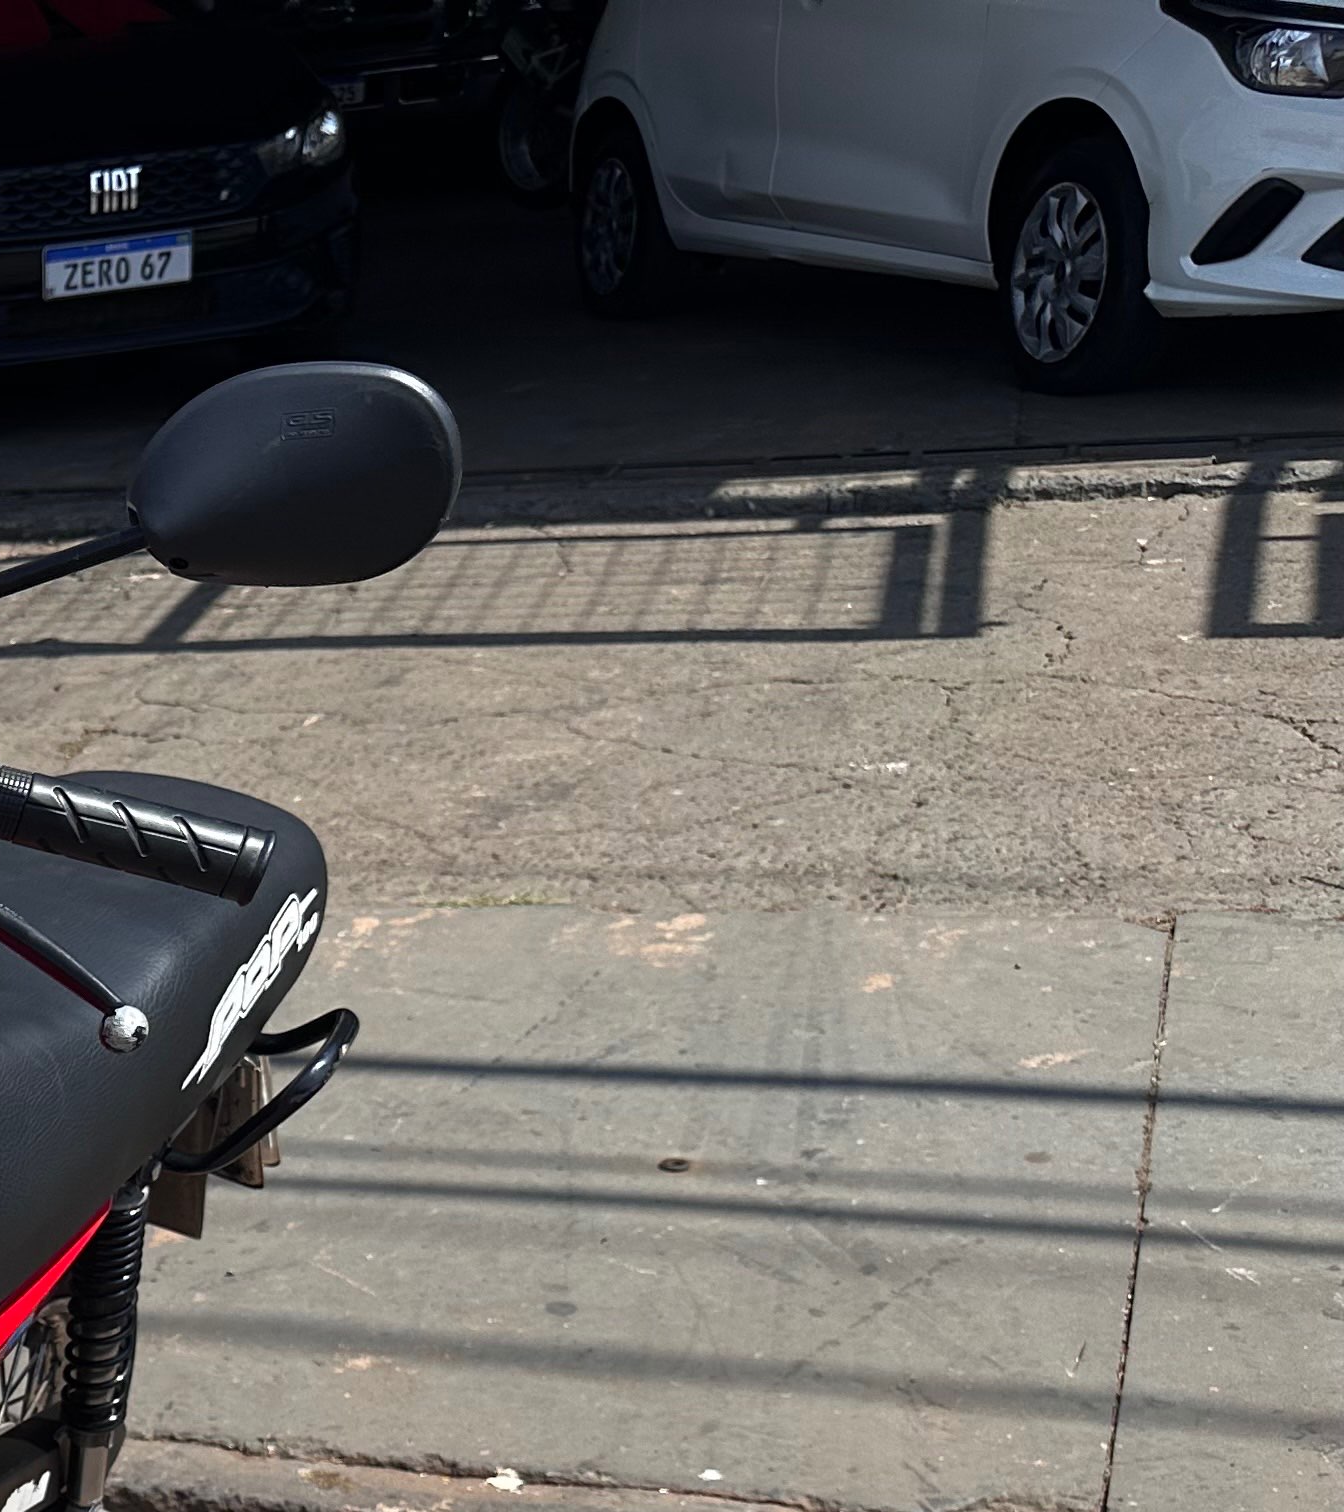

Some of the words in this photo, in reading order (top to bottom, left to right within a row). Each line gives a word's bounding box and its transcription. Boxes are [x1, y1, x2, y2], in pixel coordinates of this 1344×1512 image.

[90, 165, 142, 214] FIAT
[63, 257, 130, 292] ZERO
[140, 251, 172, 281] 67
